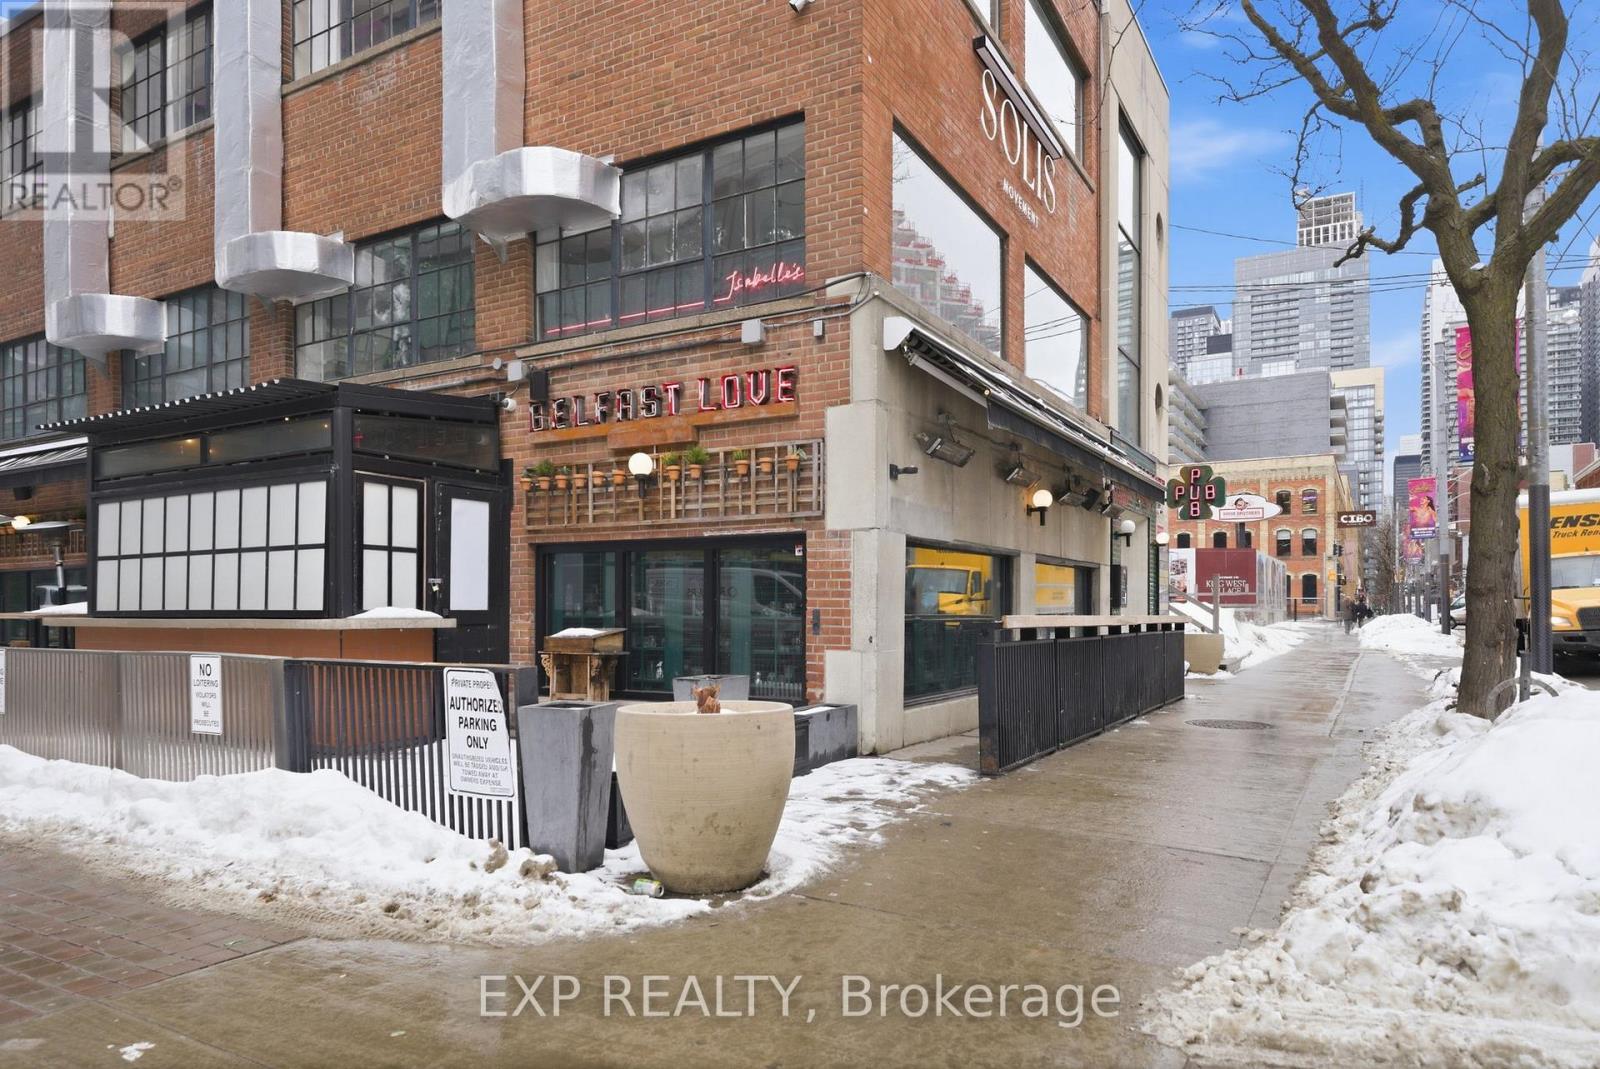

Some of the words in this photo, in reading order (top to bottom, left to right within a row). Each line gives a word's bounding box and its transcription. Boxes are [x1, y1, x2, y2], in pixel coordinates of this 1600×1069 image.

[980, 69, 1056, 214] SOLIS
[1003, 177, 1040, 229] MOVEMENT
[528, 381, 681, 433] BELFAST
[698, 365, 798, 413] LOVE
[1340, 513, 1374, 524] CIBO
[1550, 513, 1600, 529] ENS
[1552, 528, 1578, 539] Truck
[1580, 528, 1600, 537] Ren
[1226, 579, 1247, 588] WEST
[199, 663, 212, 677] NO
[193, 679, 219, 688] LOITERING
[450, 677, 472, 689] PRIVATE
[449, 695, 503, 714] AUTHORIZED
[458, 716, 497, 732] PARKING
[466, 735, 489, 750] ONLY
